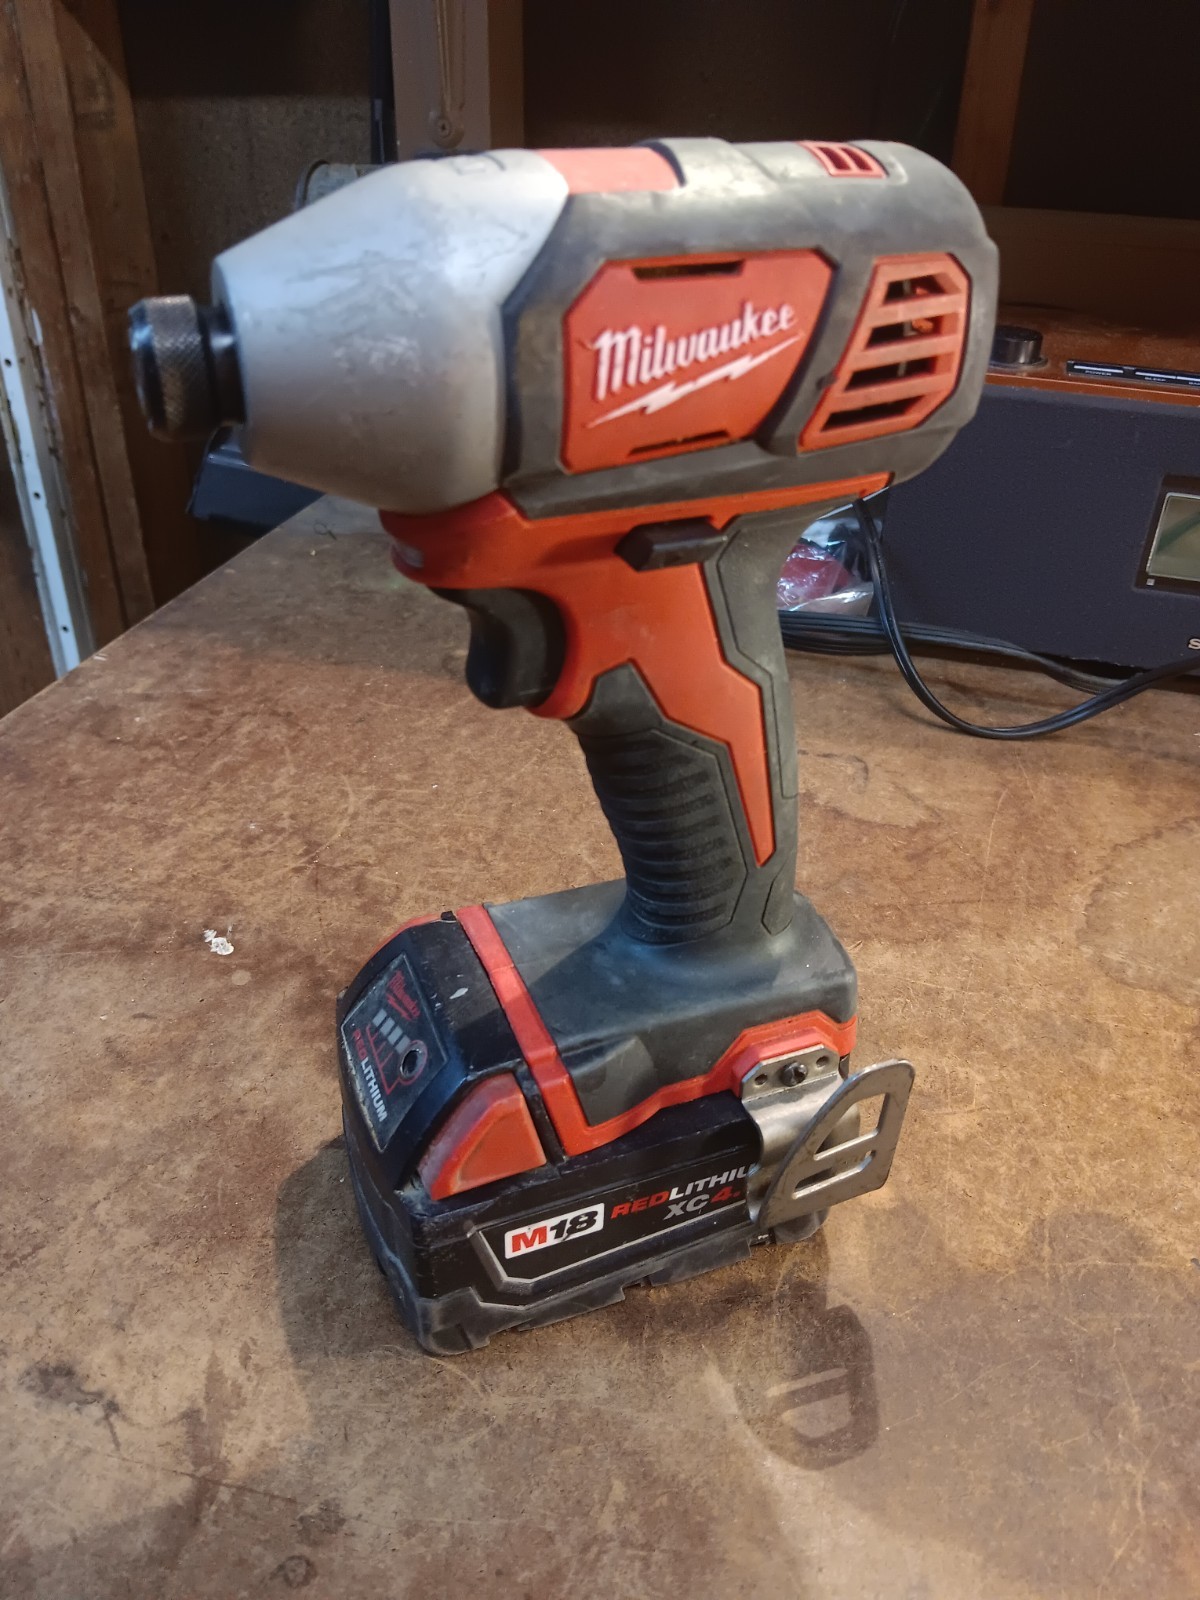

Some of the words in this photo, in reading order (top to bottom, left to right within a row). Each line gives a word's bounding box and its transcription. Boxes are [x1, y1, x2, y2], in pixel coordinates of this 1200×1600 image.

[590, 301, 798, 401] Milwaukee
[353, 1027, 388, 1123] REDLITHIUM
[511, 1210, 599, 1254] M18
